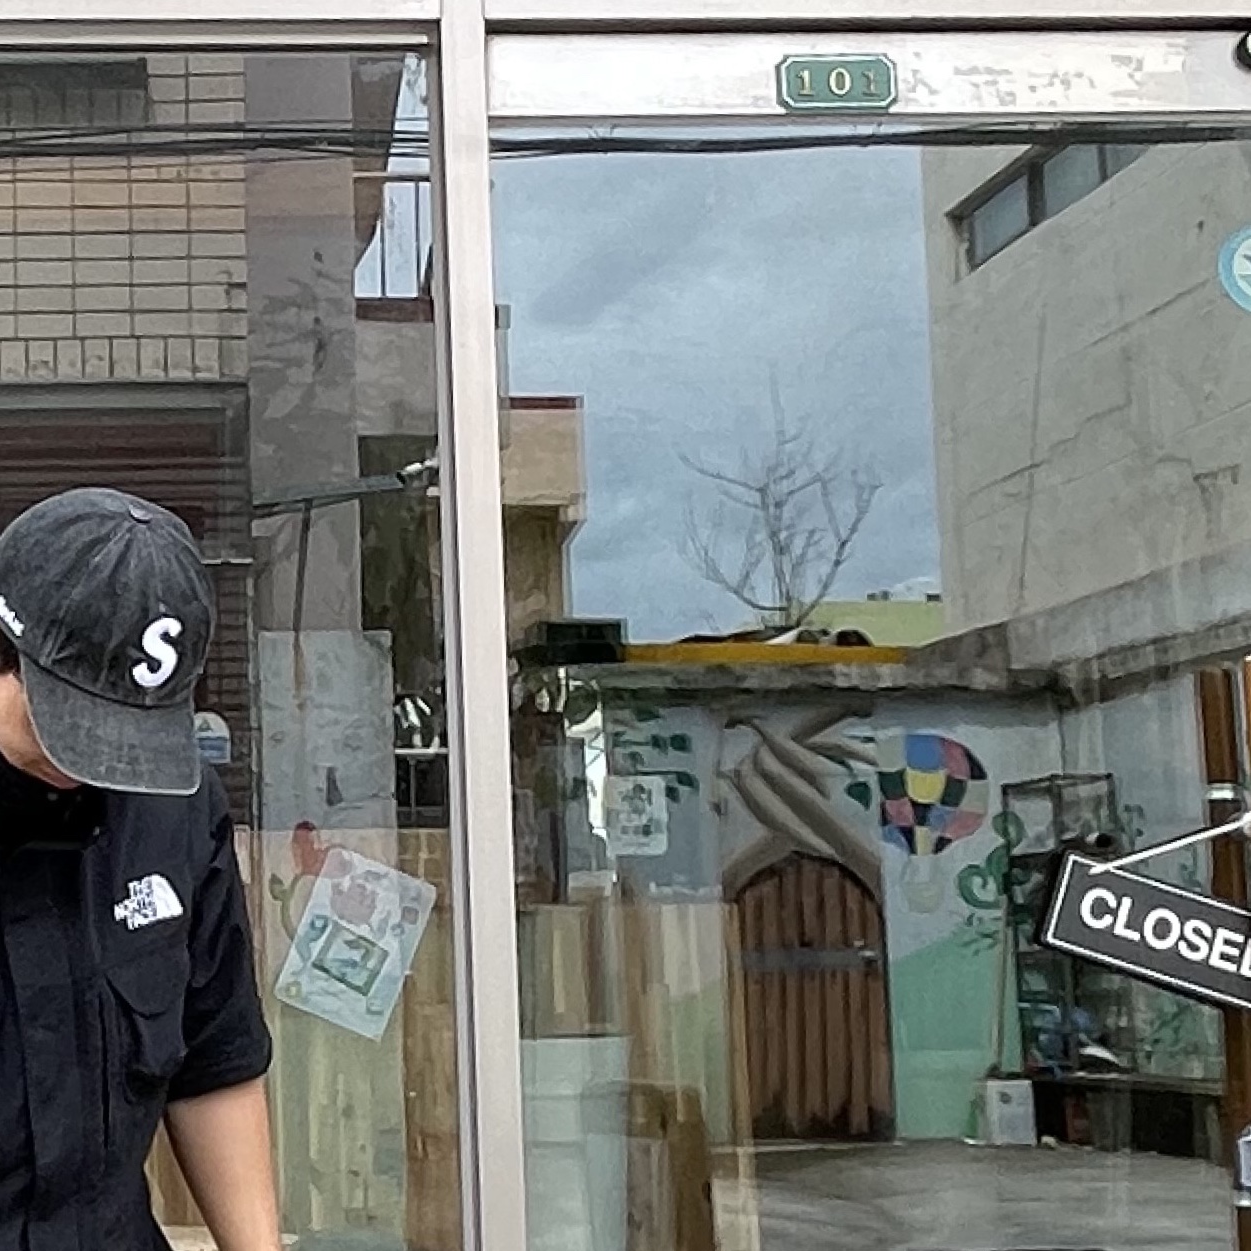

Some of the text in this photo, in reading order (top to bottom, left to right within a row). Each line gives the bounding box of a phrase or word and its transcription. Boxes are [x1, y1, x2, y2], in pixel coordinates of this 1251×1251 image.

[796, 68, 881, 97] 101
[132, 617, 183, 688] S
[128, 878, 153, 900] THE
[114, 892, 156, 922] NORTH
